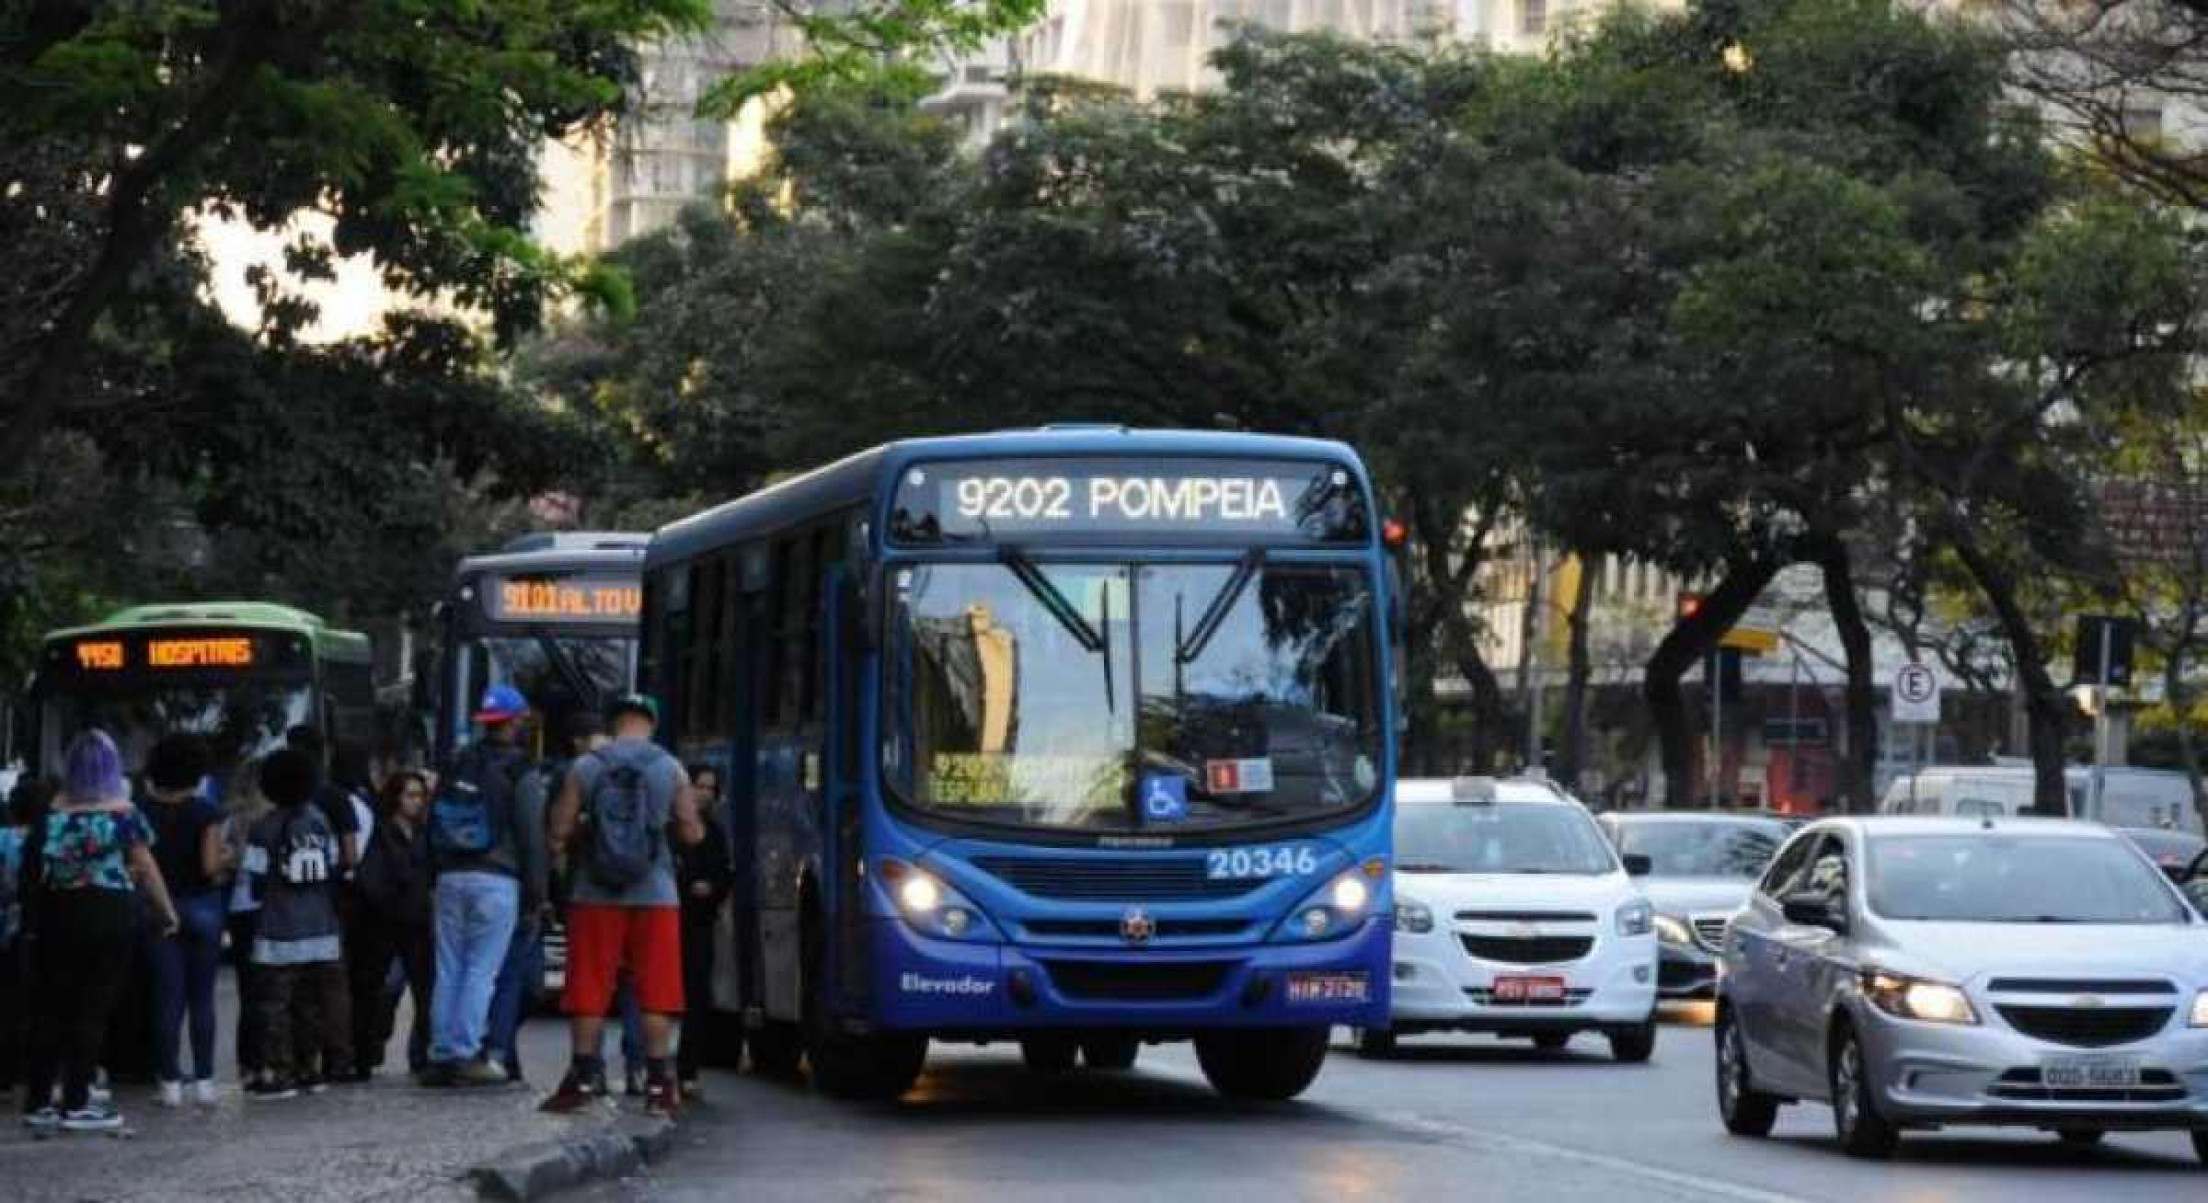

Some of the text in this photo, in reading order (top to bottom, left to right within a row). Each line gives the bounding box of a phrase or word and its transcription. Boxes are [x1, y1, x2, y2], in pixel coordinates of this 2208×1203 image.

[957, 477, 1285, 519] 9202 POMPEIA
[1207, 846, 1317, 880] 20346
[902, 972, 996, 995] Elevador
